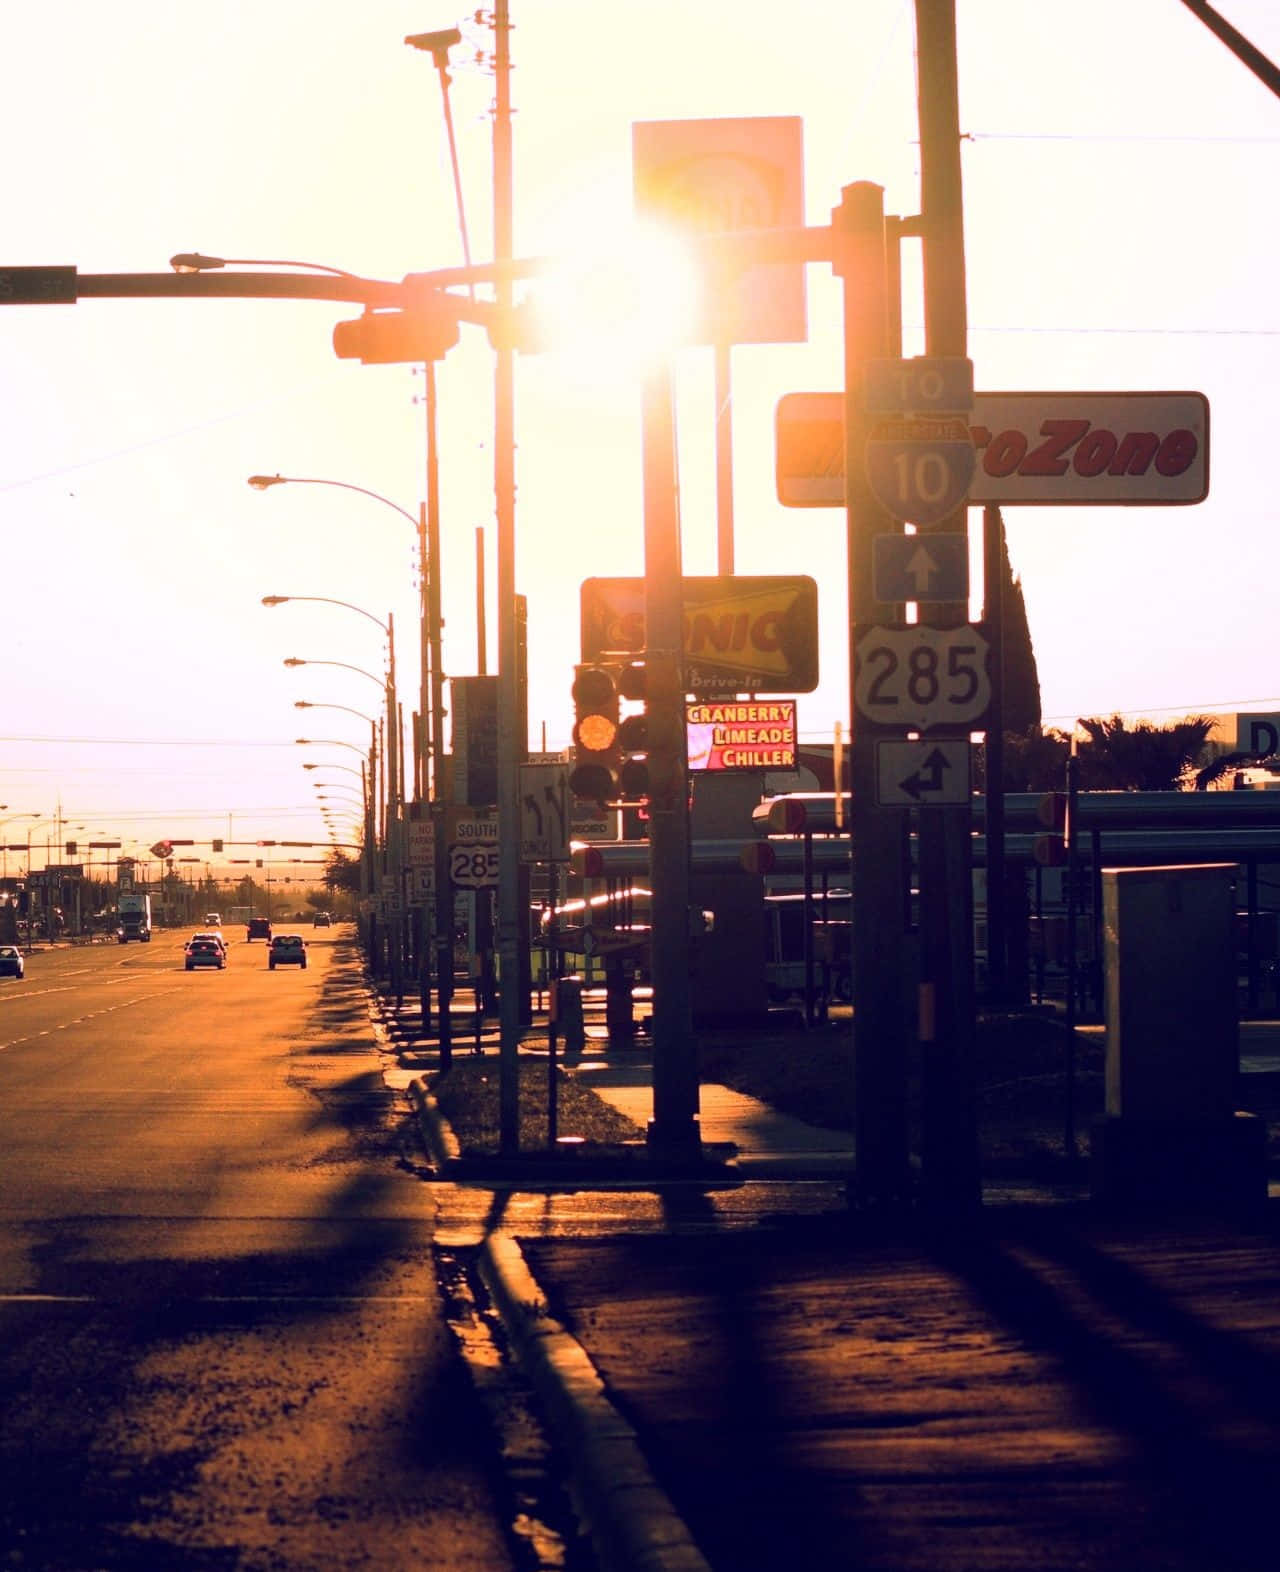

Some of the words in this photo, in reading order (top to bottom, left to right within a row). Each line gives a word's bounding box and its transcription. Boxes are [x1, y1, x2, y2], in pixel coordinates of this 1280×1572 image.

[895, 369, 945, 400] TO
[893, 451, 950, 503] 10
[691, 674, 762, 688] Drive-In
[866, 645, 979, 705] 285
[688, 706, 792, 723] CRANBERRY
[714, 728, 793, 744] LIMEADE
[722, 749, 794, 767] CHILLER
[458, 823, 497, 838] SOUTH
[454, 853, 500, 878] 285
